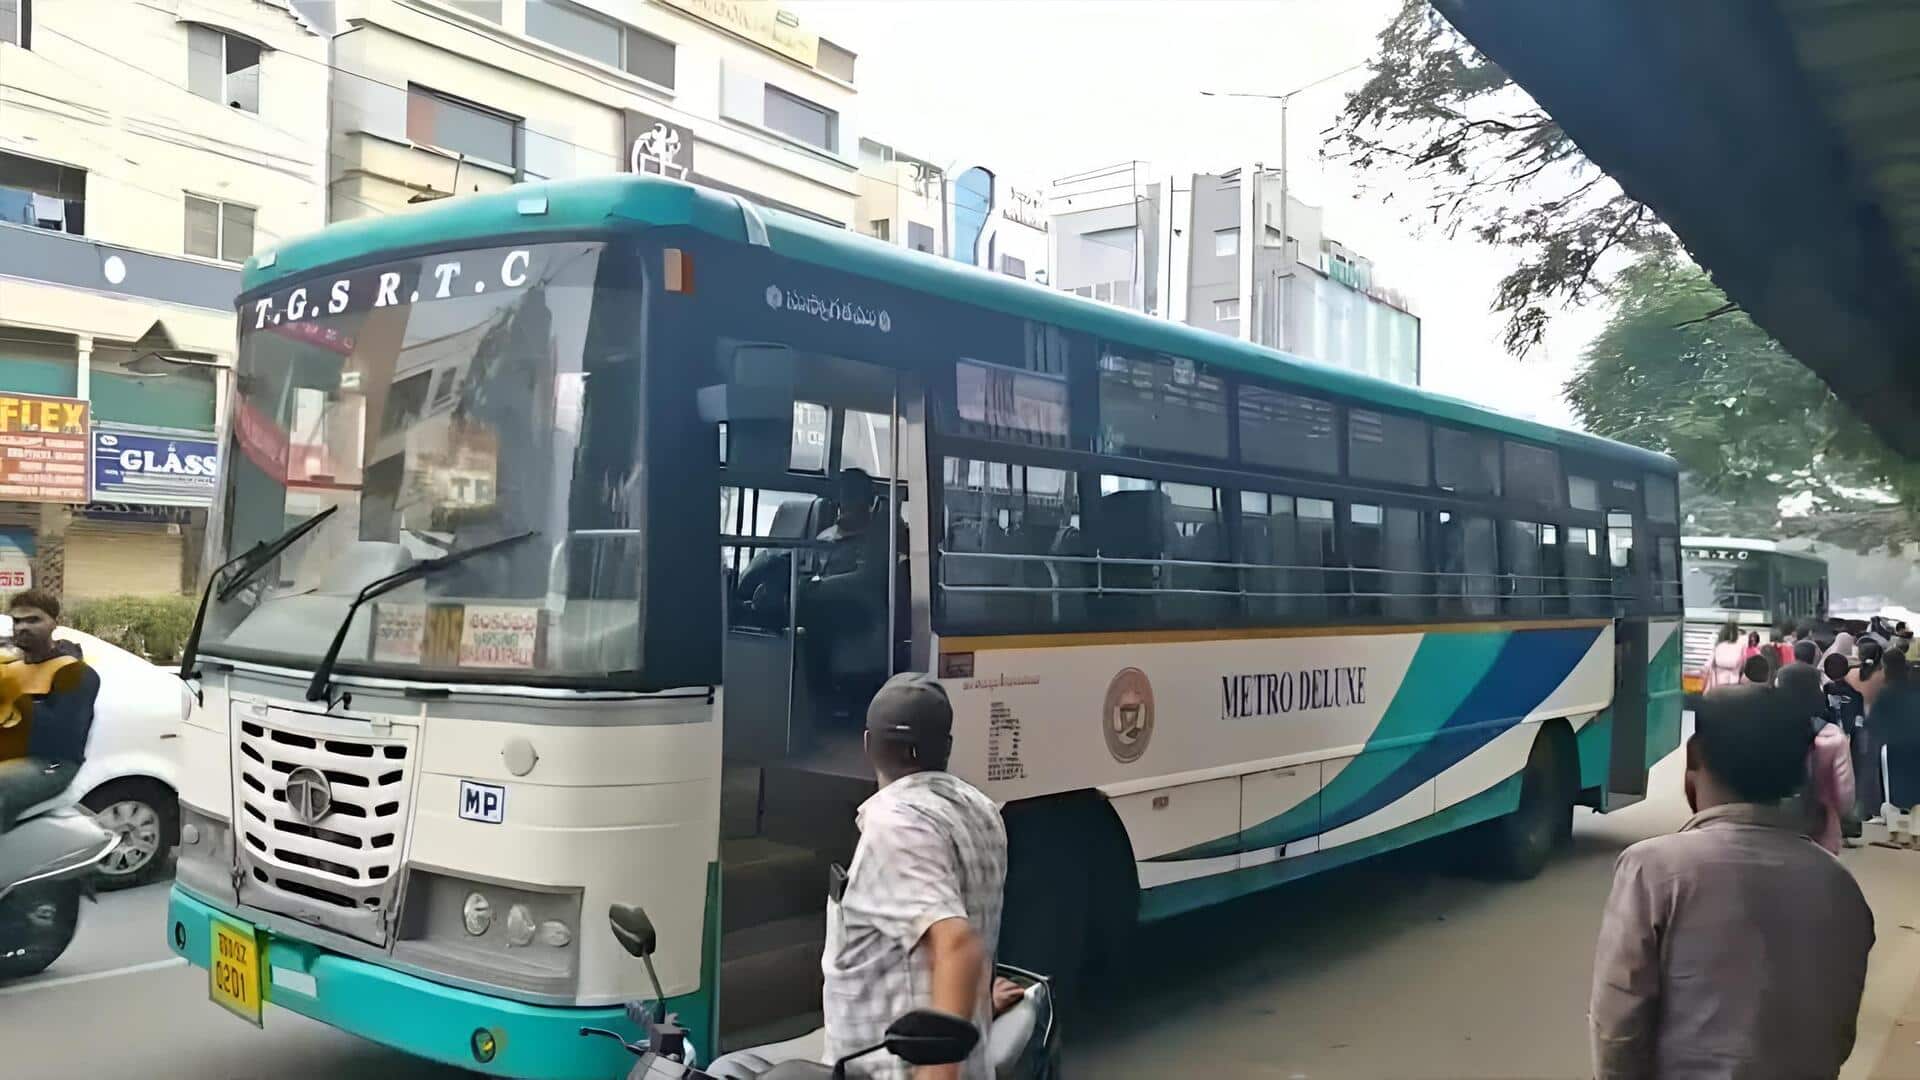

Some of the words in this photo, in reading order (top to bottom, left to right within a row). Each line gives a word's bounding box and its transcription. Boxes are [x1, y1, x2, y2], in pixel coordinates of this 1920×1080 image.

[1221, 673, 1293, 720] METRO
[1299, 667, 1367, 711] DELUXE
[465, 788, 498, 817] MP
